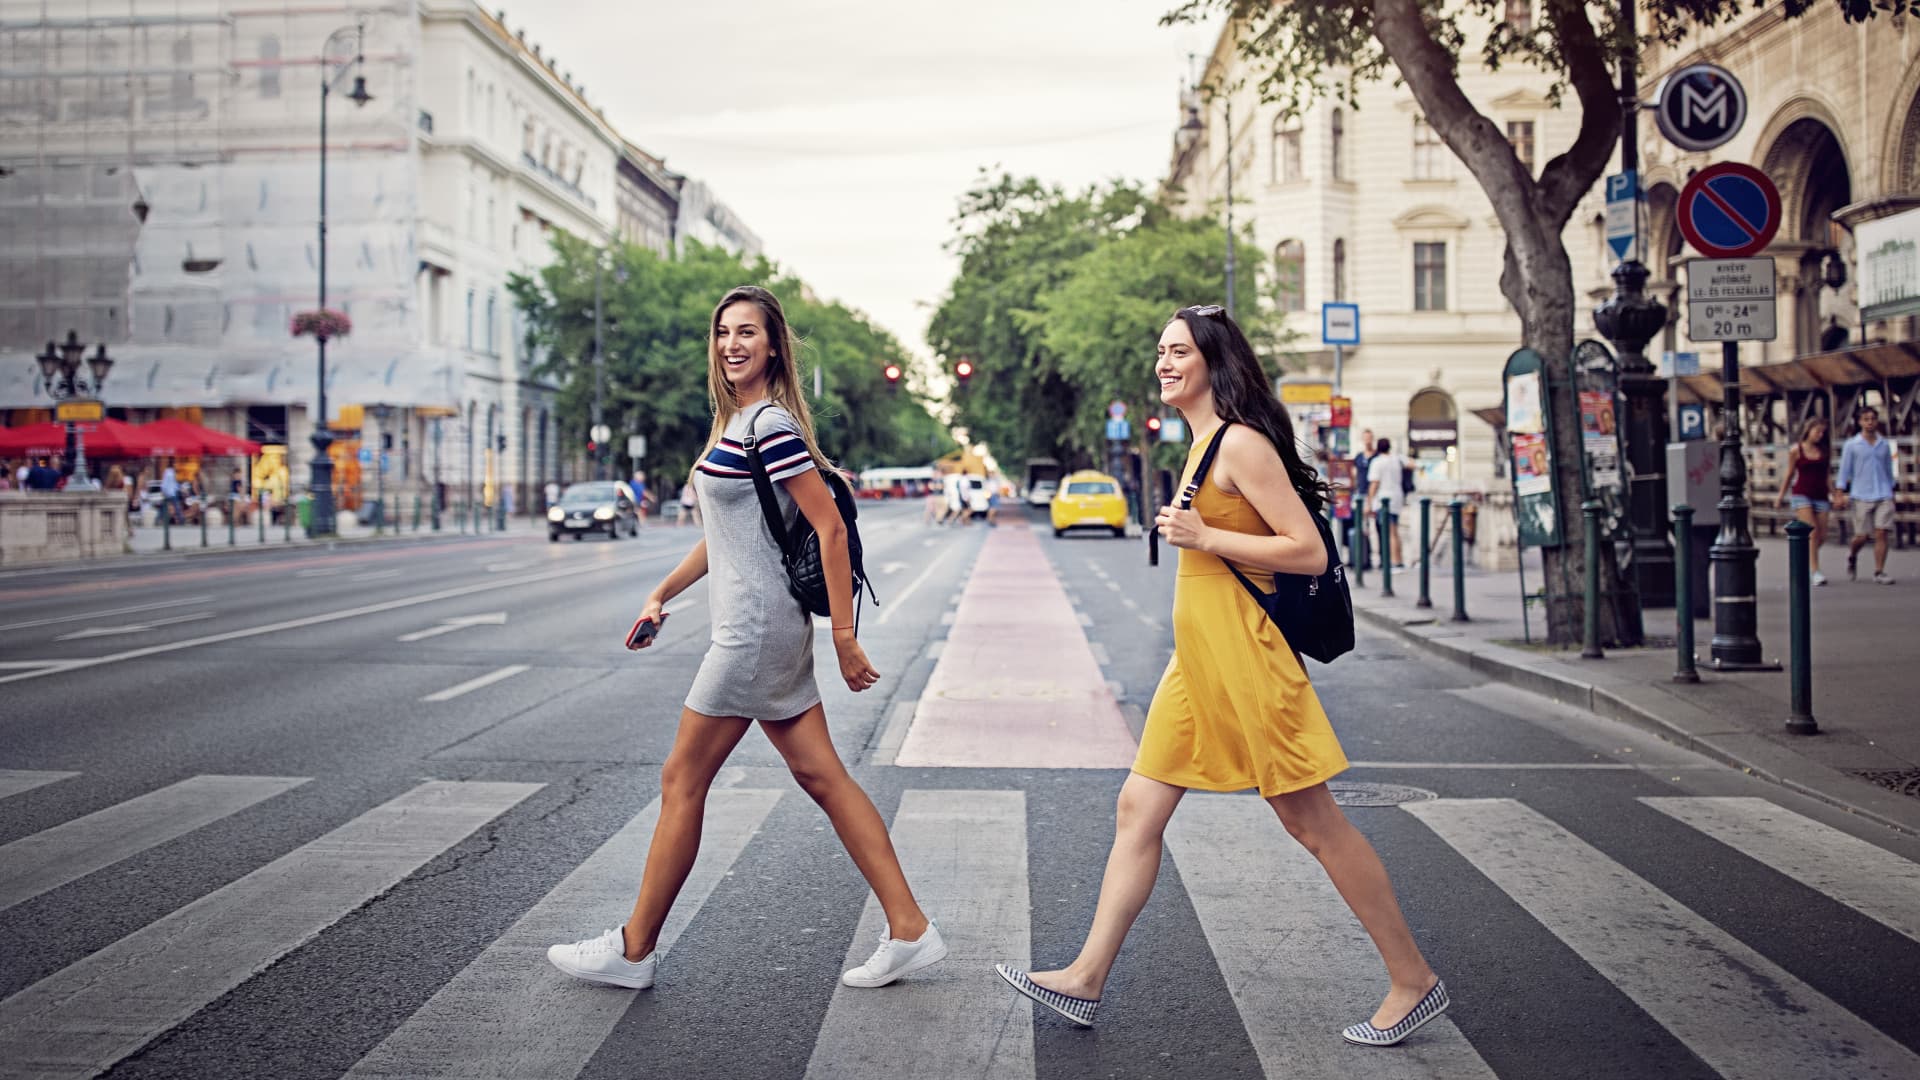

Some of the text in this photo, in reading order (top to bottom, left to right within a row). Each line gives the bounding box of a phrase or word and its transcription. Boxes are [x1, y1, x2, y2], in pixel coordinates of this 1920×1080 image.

[1681, 83, 1727, 128] M
[1611, 175, 1629, 200] P
[1714, 321, 1752, 336] 20 m
[1682, 409, 1701, 434] P
